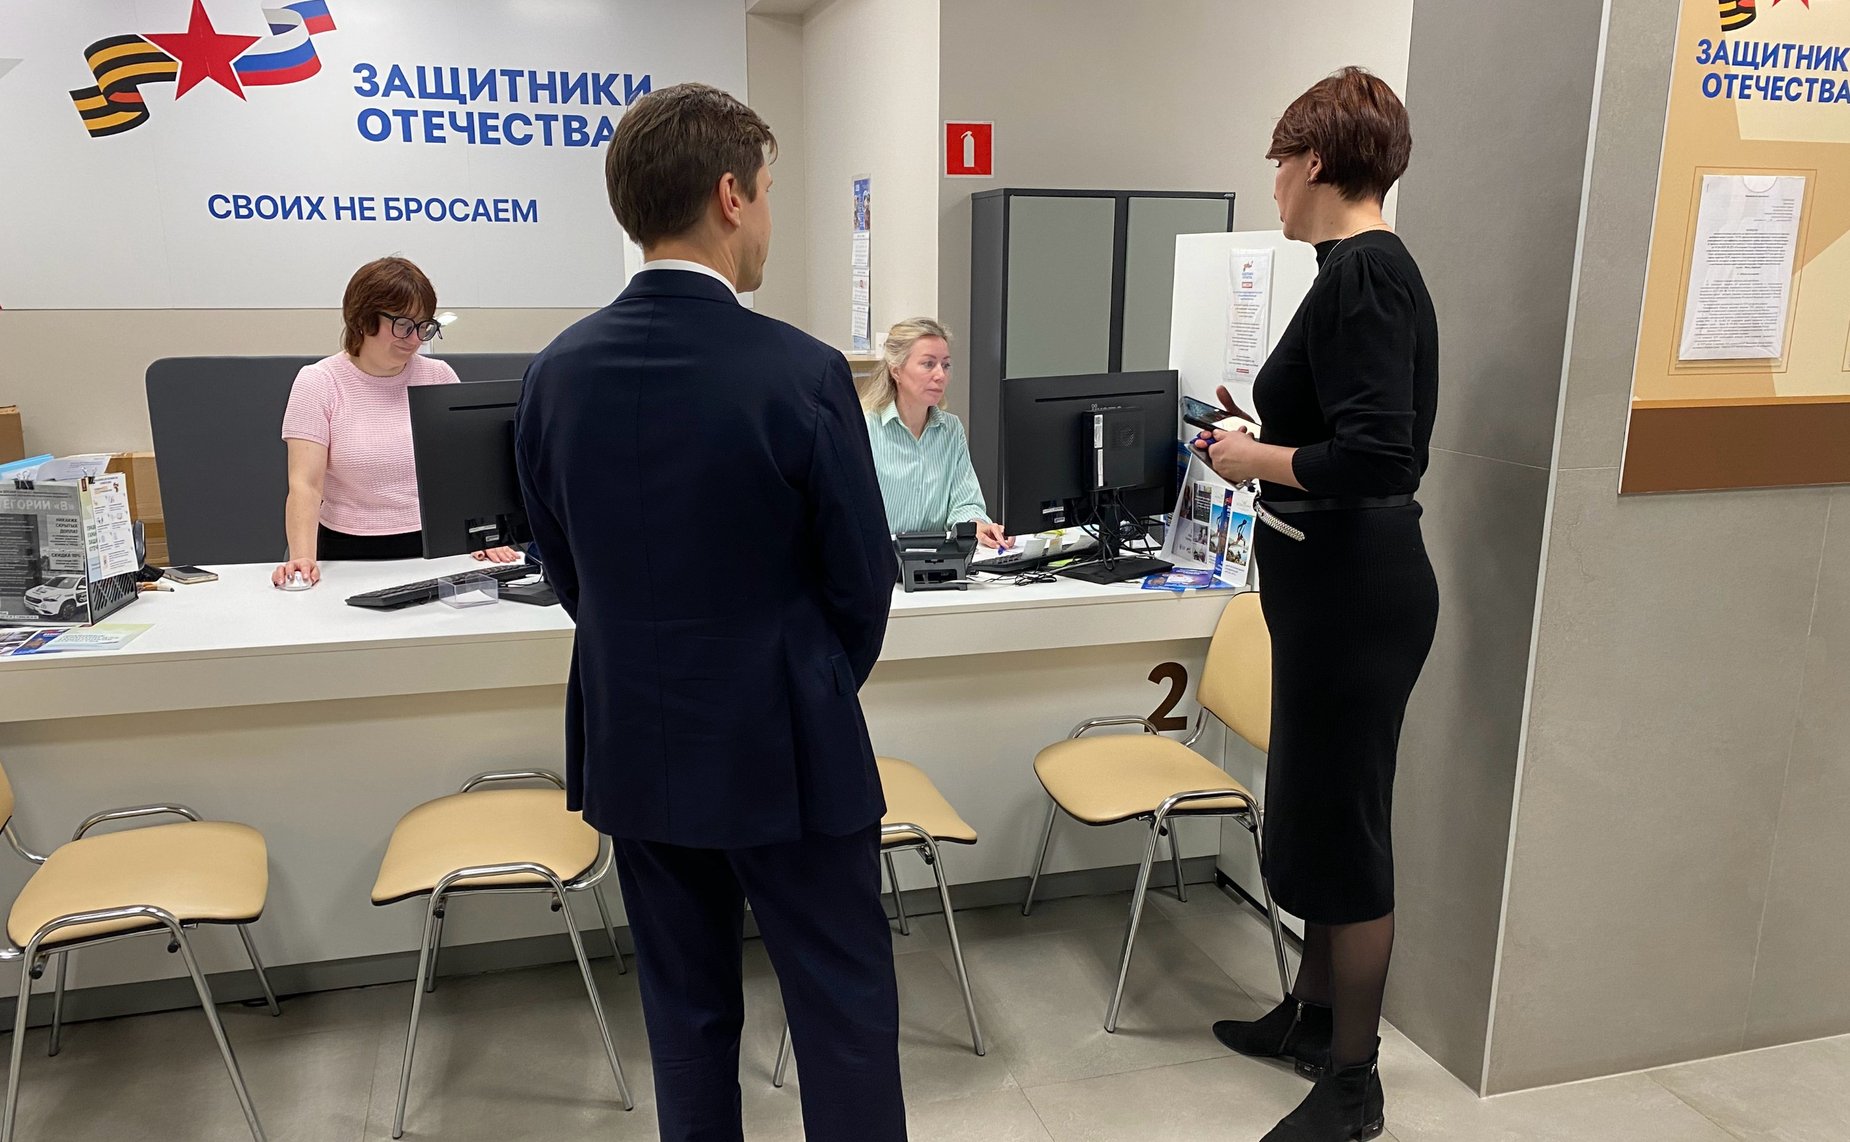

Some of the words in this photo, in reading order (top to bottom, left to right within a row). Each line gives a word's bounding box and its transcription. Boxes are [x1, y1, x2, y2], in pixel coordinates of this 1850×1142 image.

[1696, 38, 1850, 72] ЗАЩИТНИК
[352, 62, 652, 106] ЗАЩИТНИКИ
[1702, 72, 1850, 104] ОТЕЧЕСТВА
[357, 107, 614, 148] ОТЕЧЕСТВА
[208, 194, 327, 221] СВОИХ
[333, 196, 377, 221] НЕ
[383, 197, 538, 223] БРОСАЕМ
[1143, 661, 1188, 733] 2
